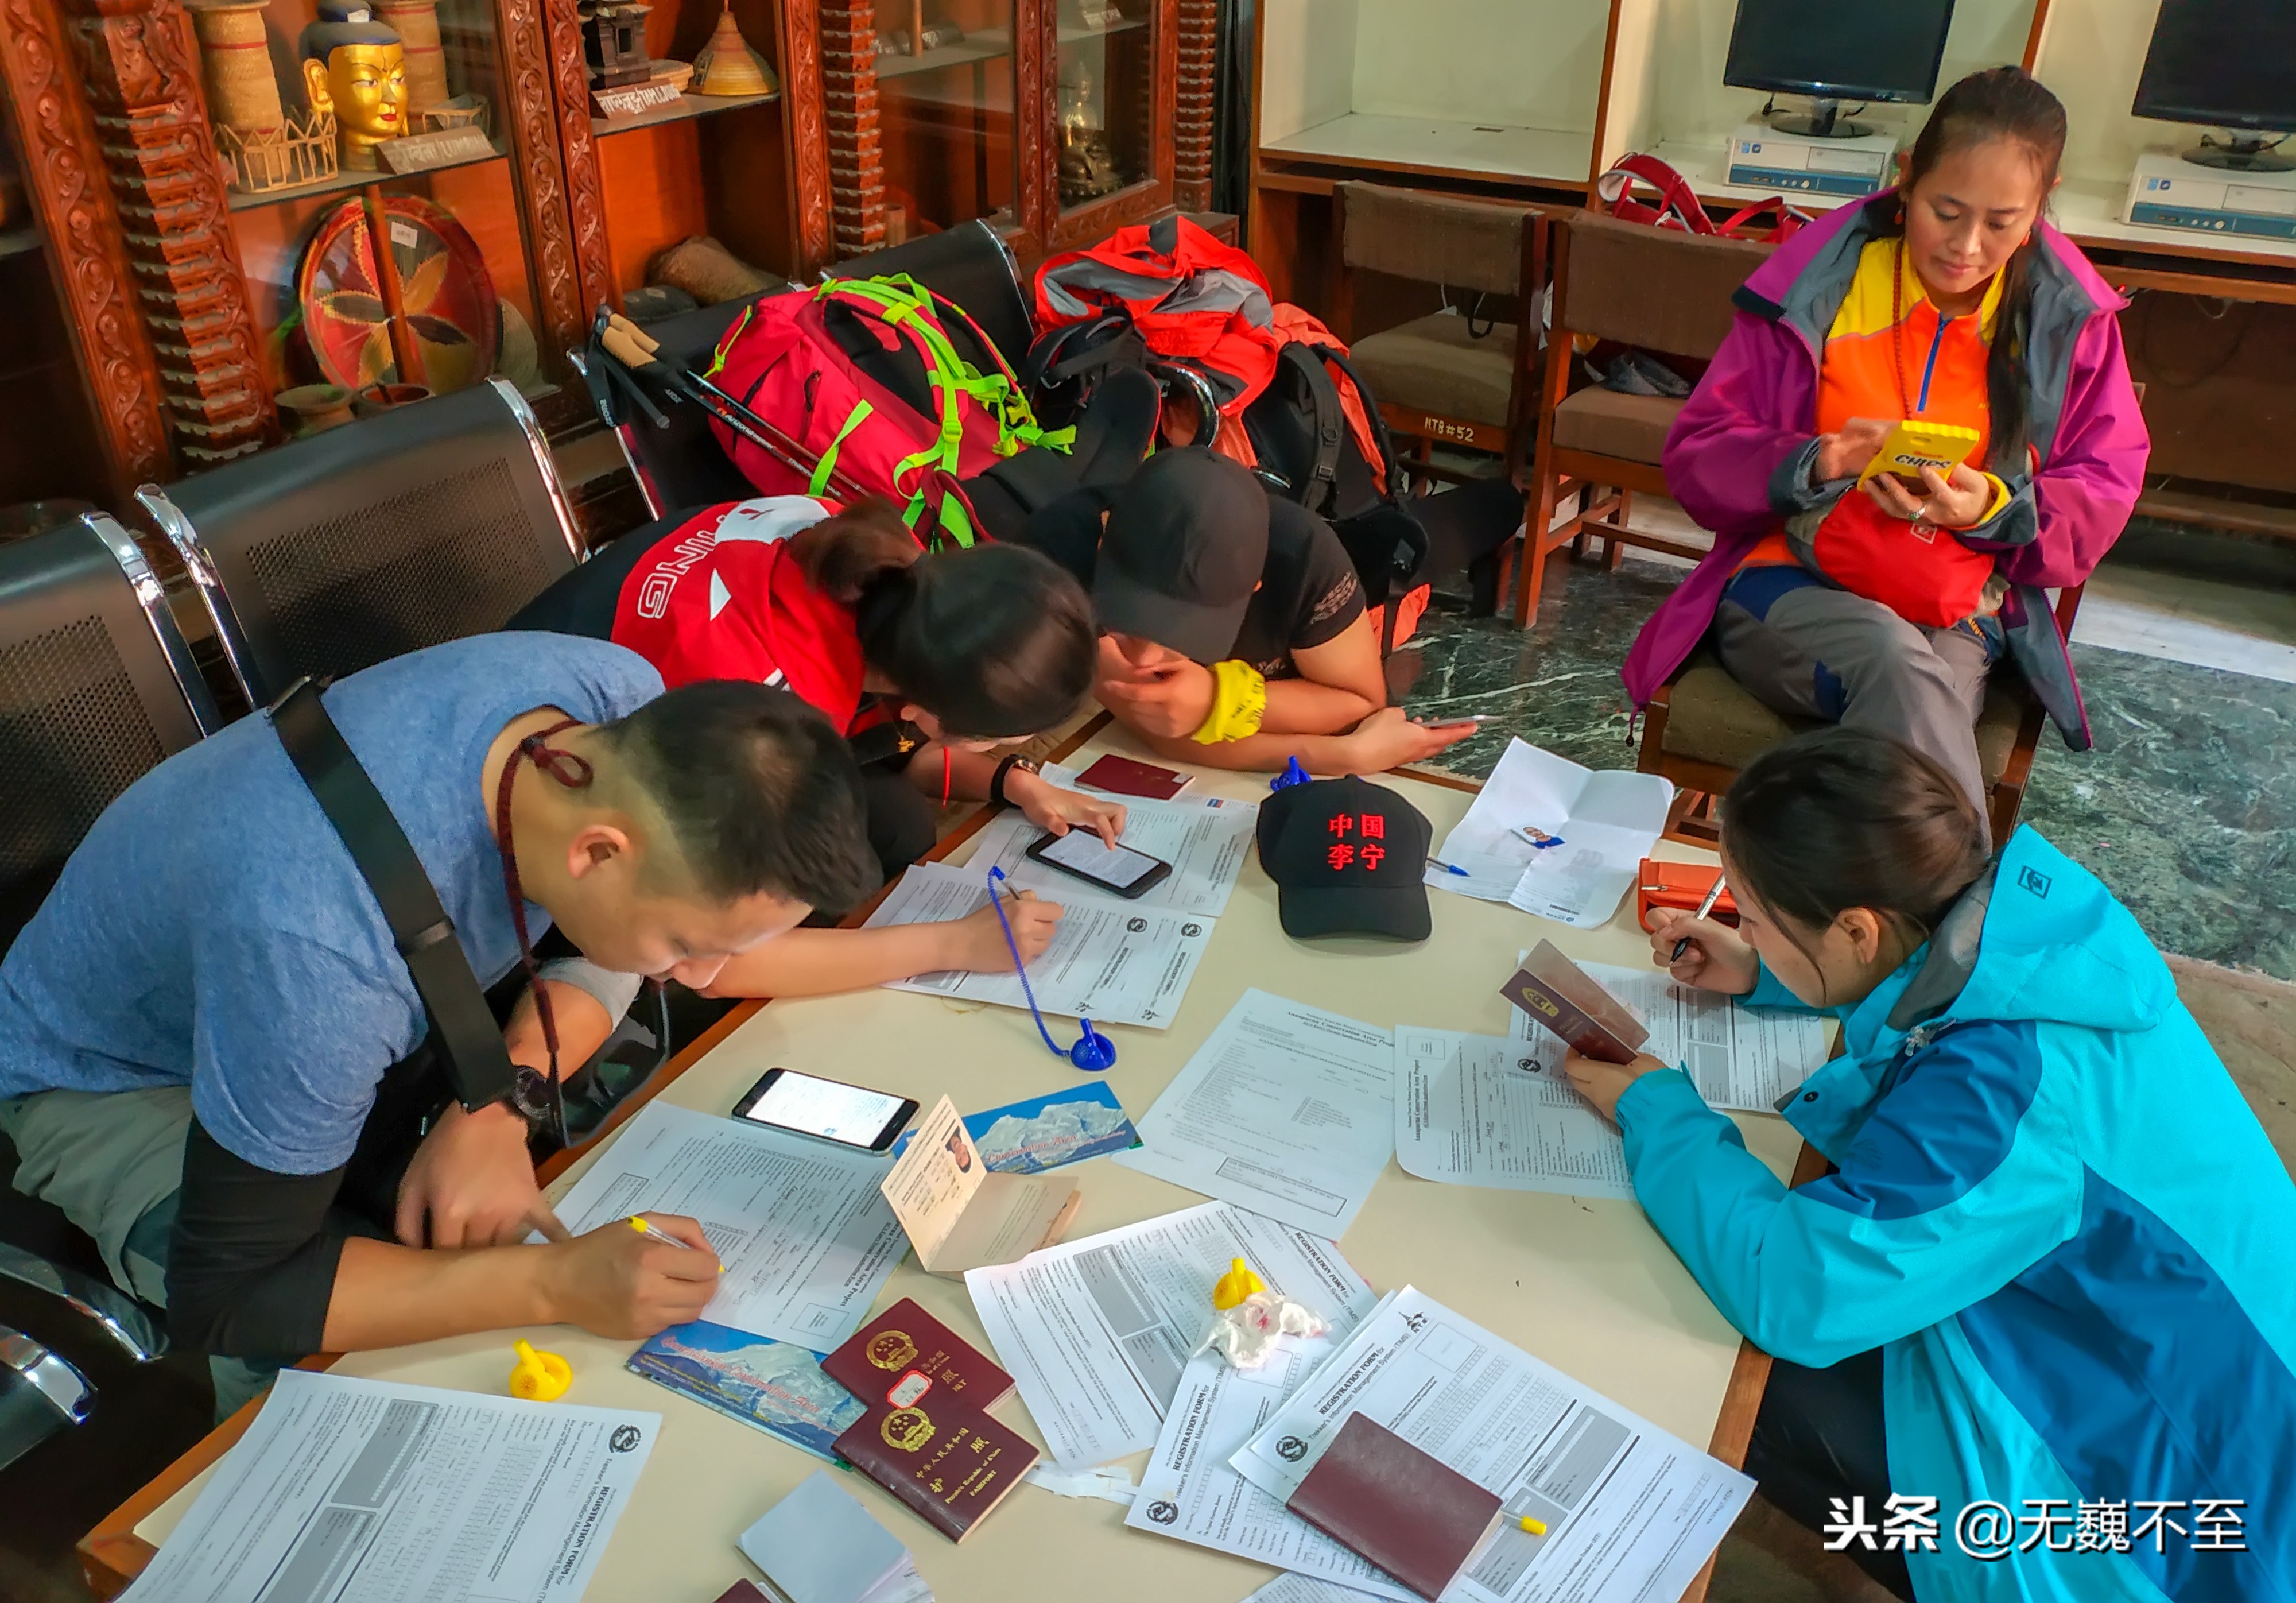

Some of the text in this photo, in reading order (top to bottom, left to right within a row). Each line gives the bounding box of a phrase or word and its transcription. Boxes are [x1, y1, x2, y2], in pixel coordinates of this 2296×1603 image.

[1895, 454, 1952, 469] CHIPS
[1328, 812, 1386, 841] 中国
[1327, 843, 1386, 871] 李宁
[1378, 1039, 1395, 1048] Proje
[864, 1235, 891, 1273] Conservation
[1293, 1230, 1351, 1299] REGISTRATION FORM for
[838, 1285, 858, 1309] Project
[854, 1271, 867, 1288] Area
[1287, 1235, 1309, 1260] Information
[1305, 1259, 1333, 1290] Management
[1328, 1286, 1347, 1307] System
[1342, 1303, 1360, 1323] (TIMS)
[1308, 1331, 1411, 1442] Trekker's Information Management System (TIMS)
[1318, 1345, 1385, 1416] REGISTRATION FORM for
[1172, 1384, 1210, 1472] REGISTRATION FORM for
[1183, 1440, 1200, 1473] Information
[1194, 1403, 1215, 1441] Management
[1208, 1381, 1222, 1403] System
[1215, 1363, 1228, 1383] (TIMS)
[593, 1455, 612, 1486] Trekker's
[914, 1422, 970, 1483] 中华人民共和国
[576, 1485, 598, 1522] Information
[553, 1519, 581, 1565] Management
[554, 1484, 610, 1586] REGISTRATION FORM for
[541, 1563, 560, 1592] System
